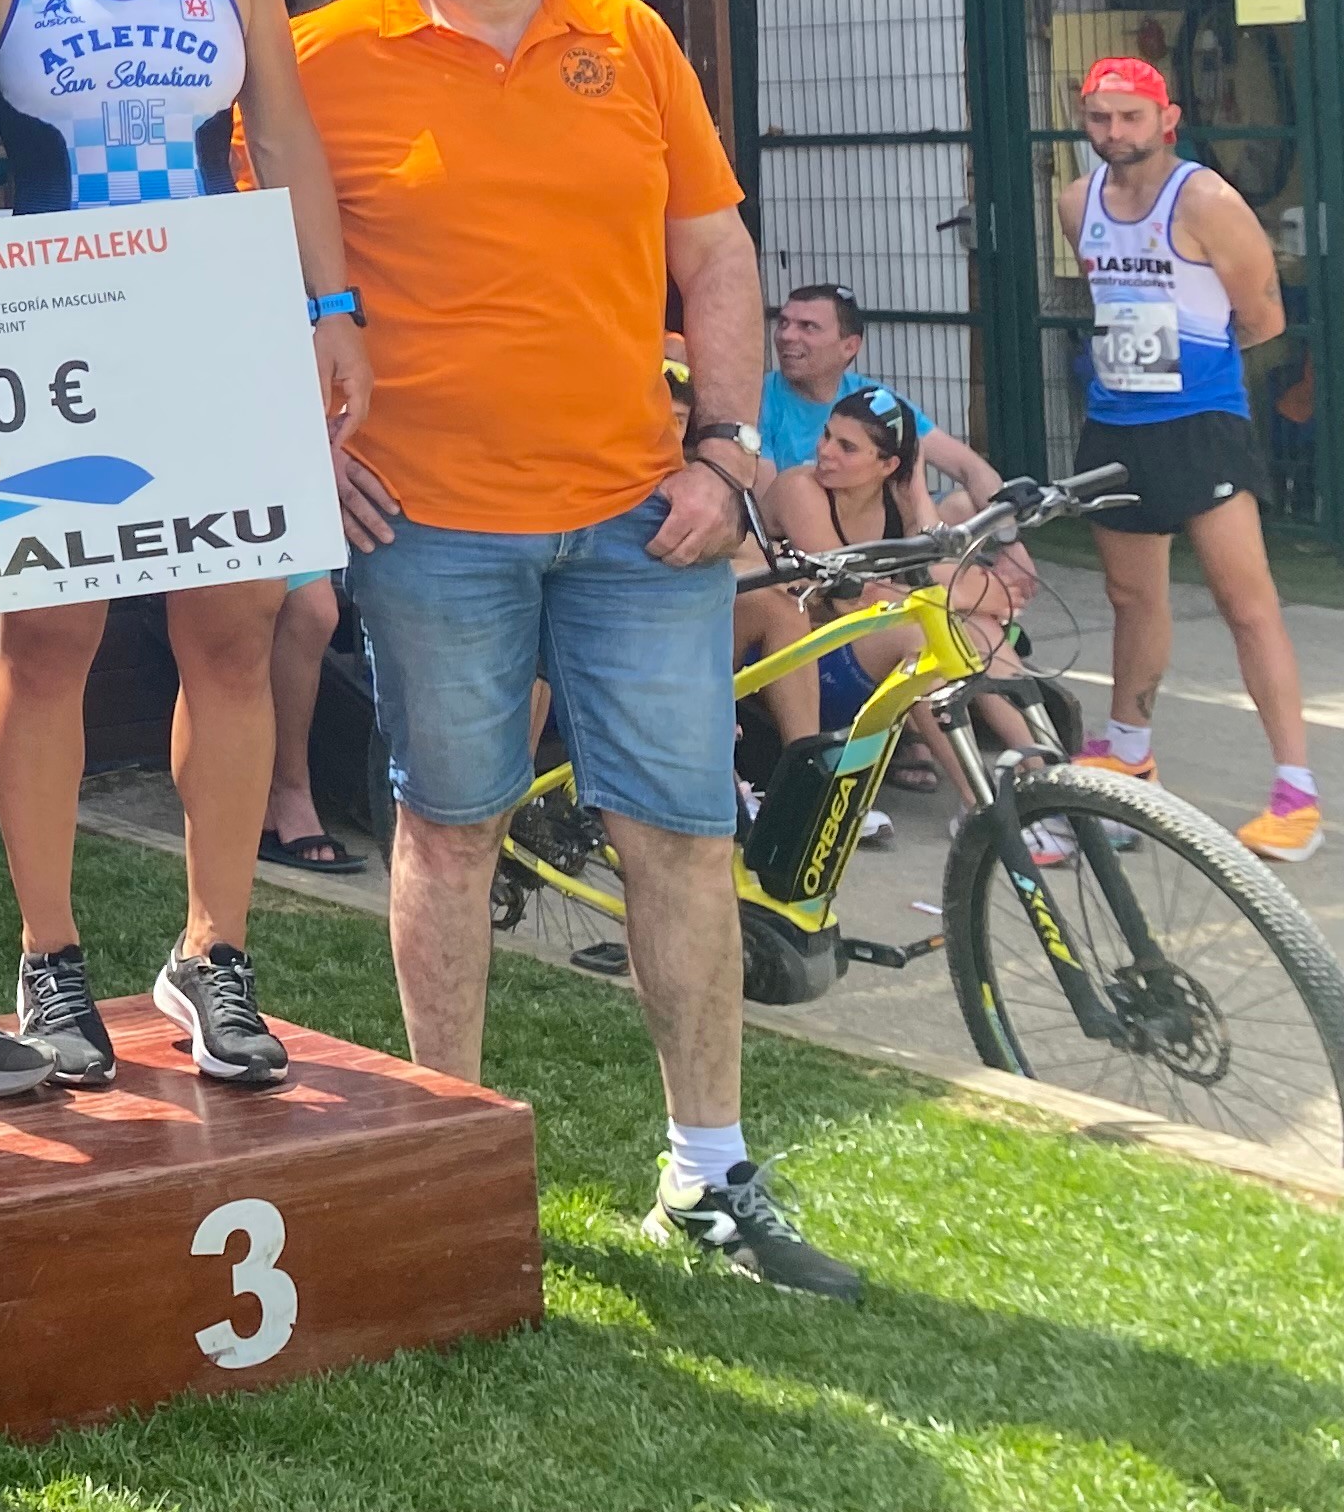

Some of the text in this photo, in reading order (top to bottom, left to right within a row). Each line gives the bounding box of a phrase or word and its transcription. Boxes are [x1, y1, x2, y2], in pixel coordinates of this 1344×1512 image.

[34, 14, 86, 28] austral
[39, 24, 218, 75] ATLETICO
[51, 61, 212, 96] San Sebastian
[101, 98, 166, 148] LIBE
[52, 290, 126, 309] MASCULINA
[1103, 332, 1162, 365] 189
[49, 360, 96, 424] €
[54, 551, 294, 593] TRIATLOIA
[804, 778, 858, 896] ORBEA
[190, 1199, 298, 1369] 3
